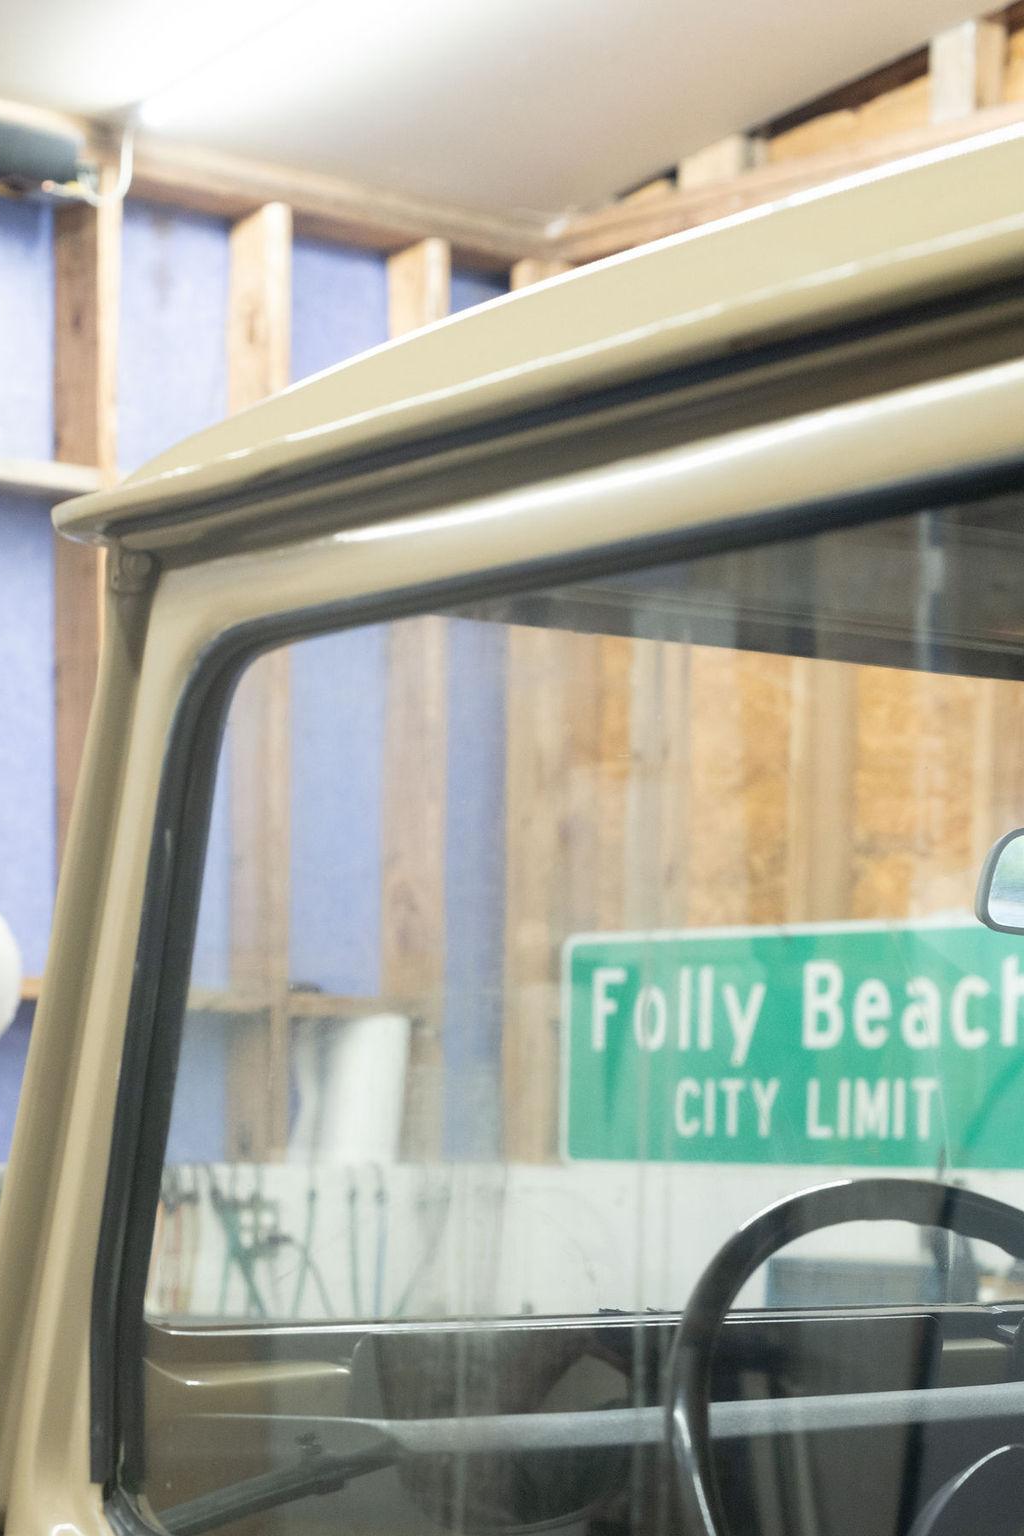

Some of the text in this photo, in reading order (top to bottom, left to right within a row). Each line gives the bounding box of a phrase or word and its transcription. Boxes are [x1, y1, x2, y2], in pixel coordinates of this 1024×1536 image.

[591, 966, 766, 1067] Folly
[675, 1077, 940, 1140] CITY LIMIT
